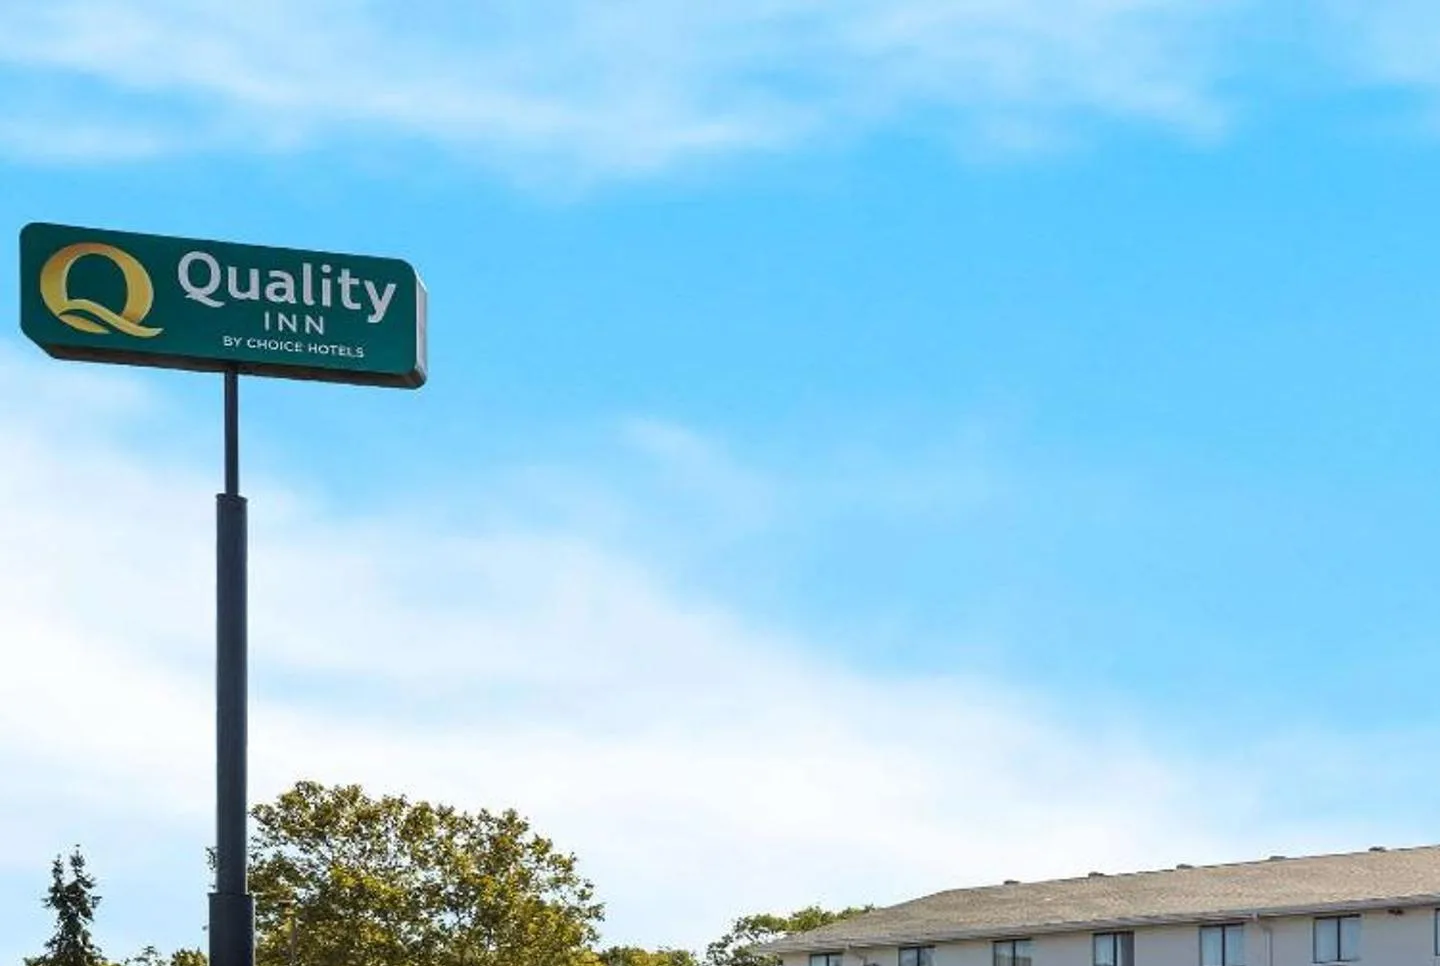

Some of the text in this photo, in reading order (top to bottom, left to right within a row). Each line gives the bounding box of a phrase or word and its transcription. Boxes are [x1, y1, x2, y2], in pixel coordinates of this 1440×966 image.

[40, 242, 164, 338] Q
[177, 250, 397, 324] Quality
[223, 335, 365, 358] BY CHOICE HOTELS
[264, 311, 324, 335] INN
